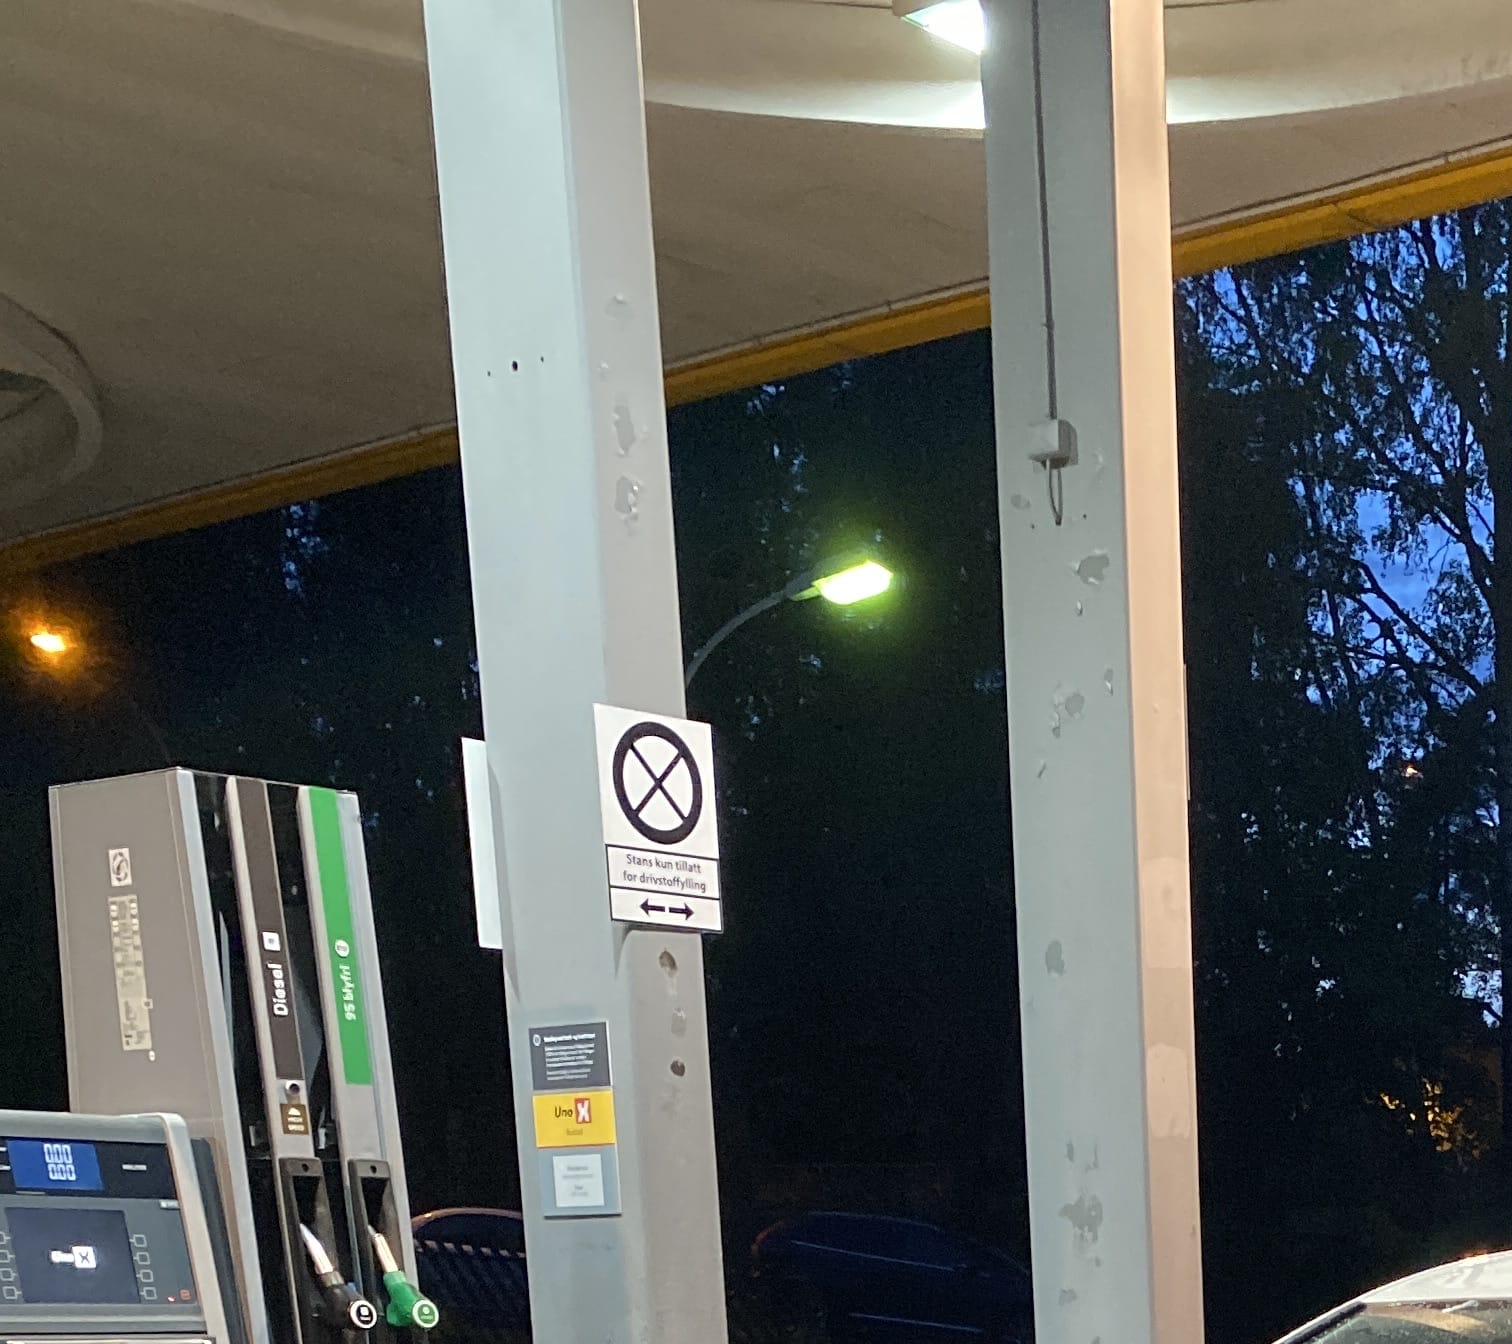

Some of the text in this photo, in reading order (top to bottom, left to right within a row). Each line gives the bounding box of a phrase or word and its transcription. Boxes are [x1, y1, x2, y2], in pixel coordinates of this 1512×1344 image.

[626, 853, 702, 874] Stans kun tillatt
[623, 870, 706, 894] for drivstoffylling
[267, 963, 289, 1016] Diesel
[555, 1105, 573, 1119] Uno
